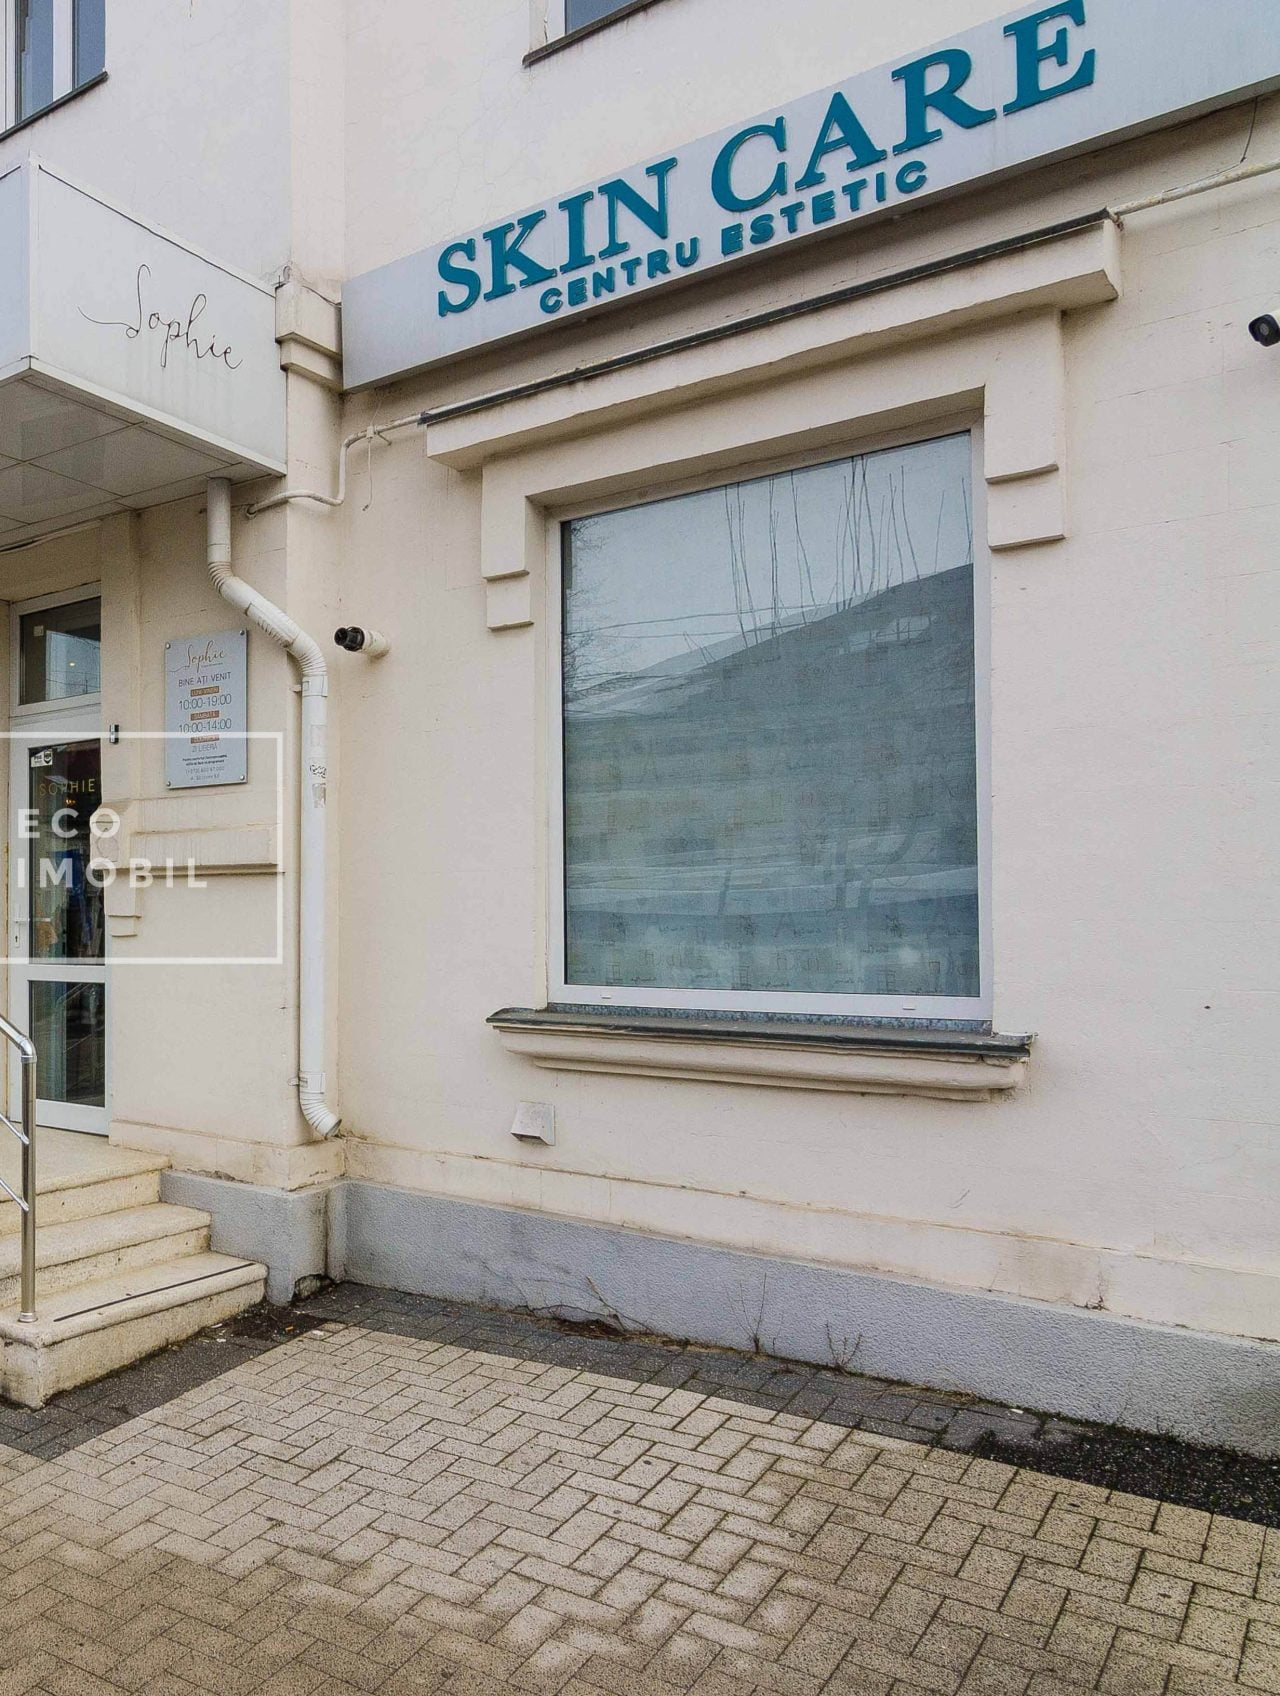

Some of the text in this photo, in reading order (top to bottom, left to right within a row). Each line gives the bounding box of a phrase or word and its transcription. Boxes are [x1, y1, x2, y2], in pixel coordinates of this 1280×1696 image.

[438, 0, 1096, 317] SKIN CARE
[539, 160, 928, 314] CENTRU ESTETIC
[77, 264, 243, 371] Sophie
[170, 640, 225, 673] Sophie
[178, 677, 195, 687] BINE
[210, 671, 232, 682] VENIT
[178, 693, 232, 711] 10:00-19:00
[178, 718, 232, 735] 10:00-14:00
